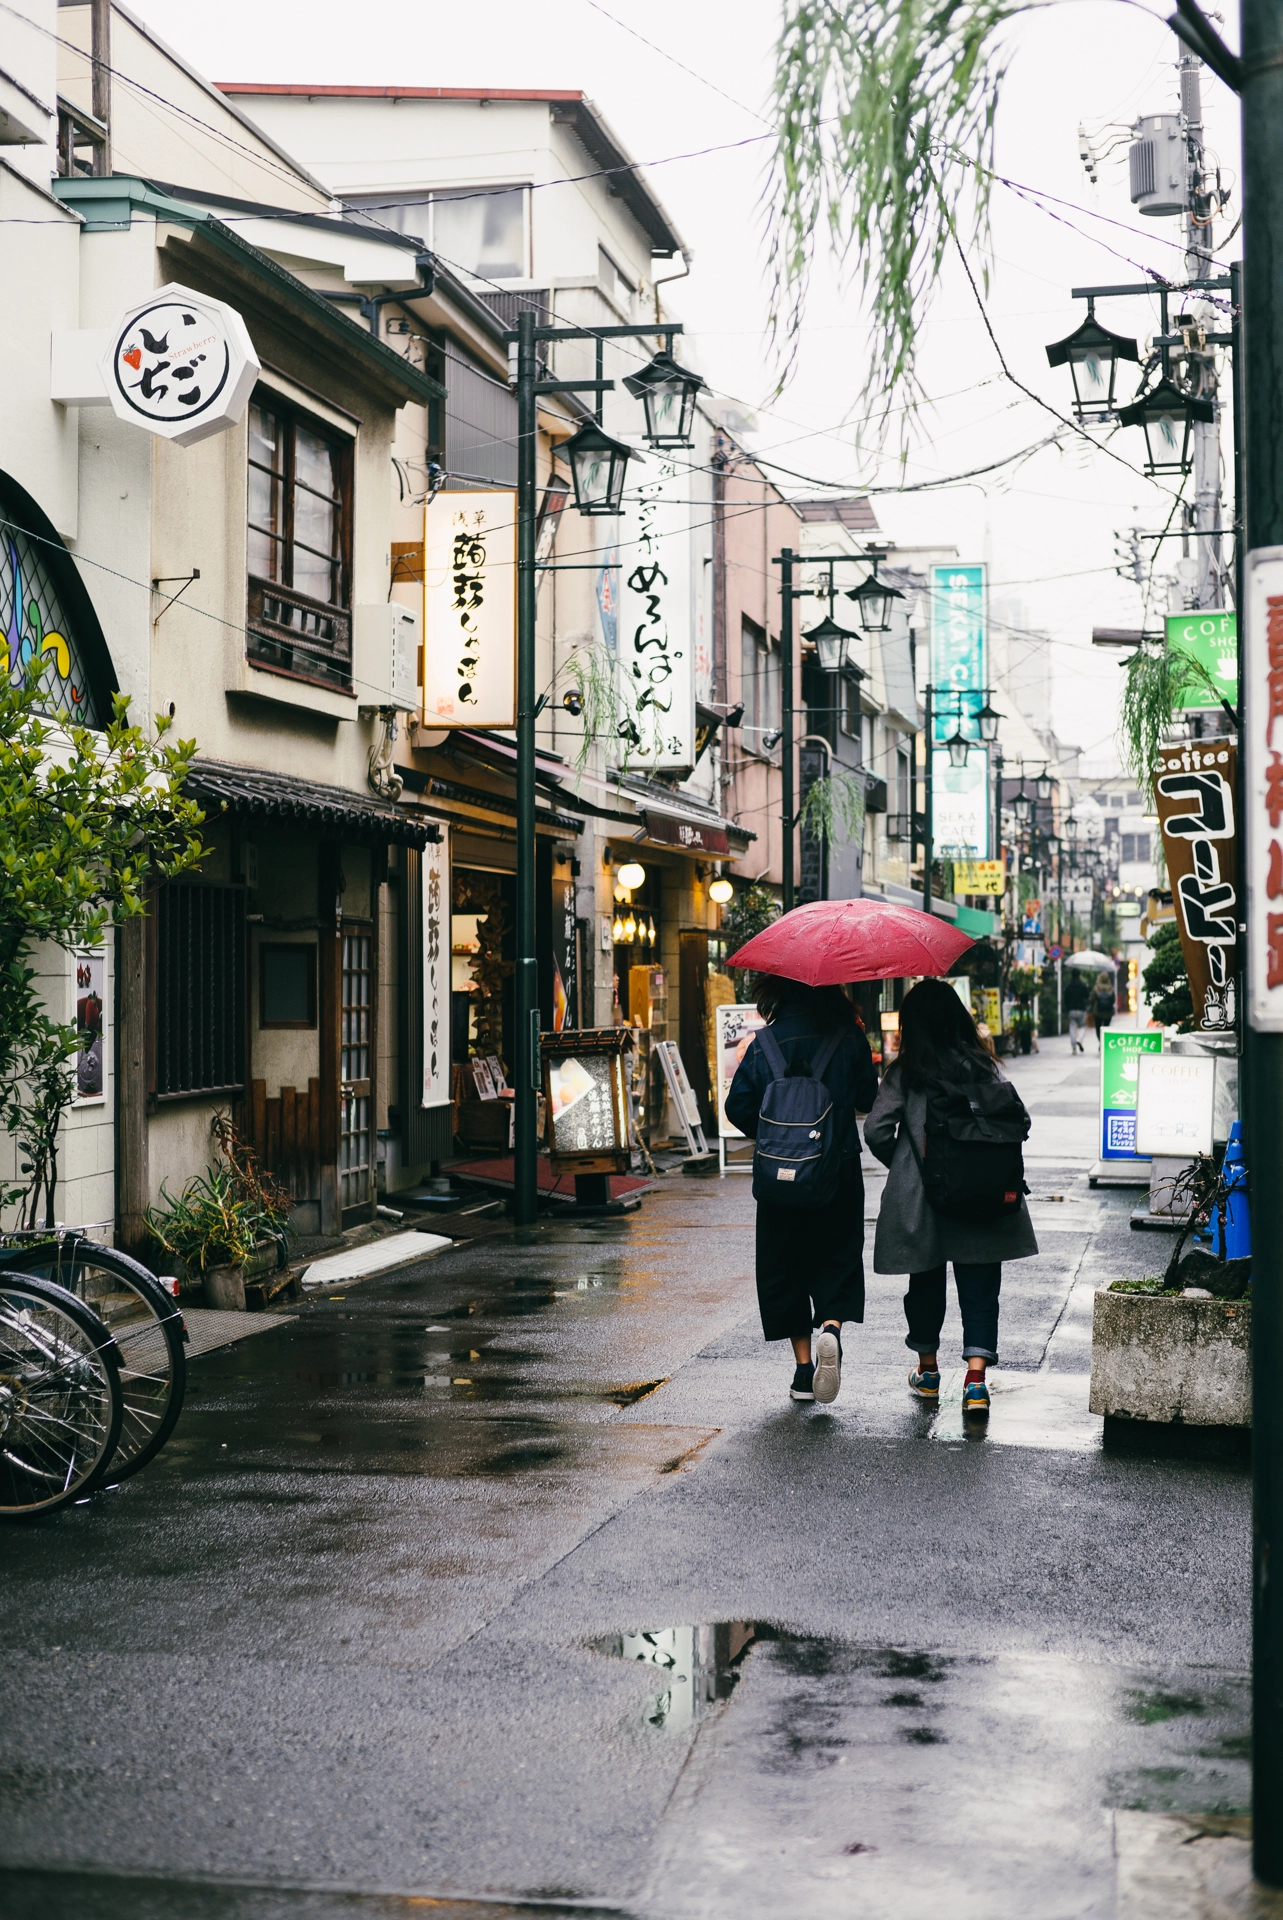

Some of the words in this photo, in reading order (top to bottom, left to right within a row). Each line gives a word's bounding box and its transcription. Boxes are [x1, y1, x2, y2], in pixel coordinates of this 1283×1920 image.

[168, 334, 217, 361] Strawberry
[453, 510, 487, 528] 浅草
[1183, 619, 1231, 641] COF
[1158, 770, 1235, 986] コーヒー
[1108, 1036, 1157, 1050] COFFEE
[1151, 1065, 1200, 1077] COFFEE
